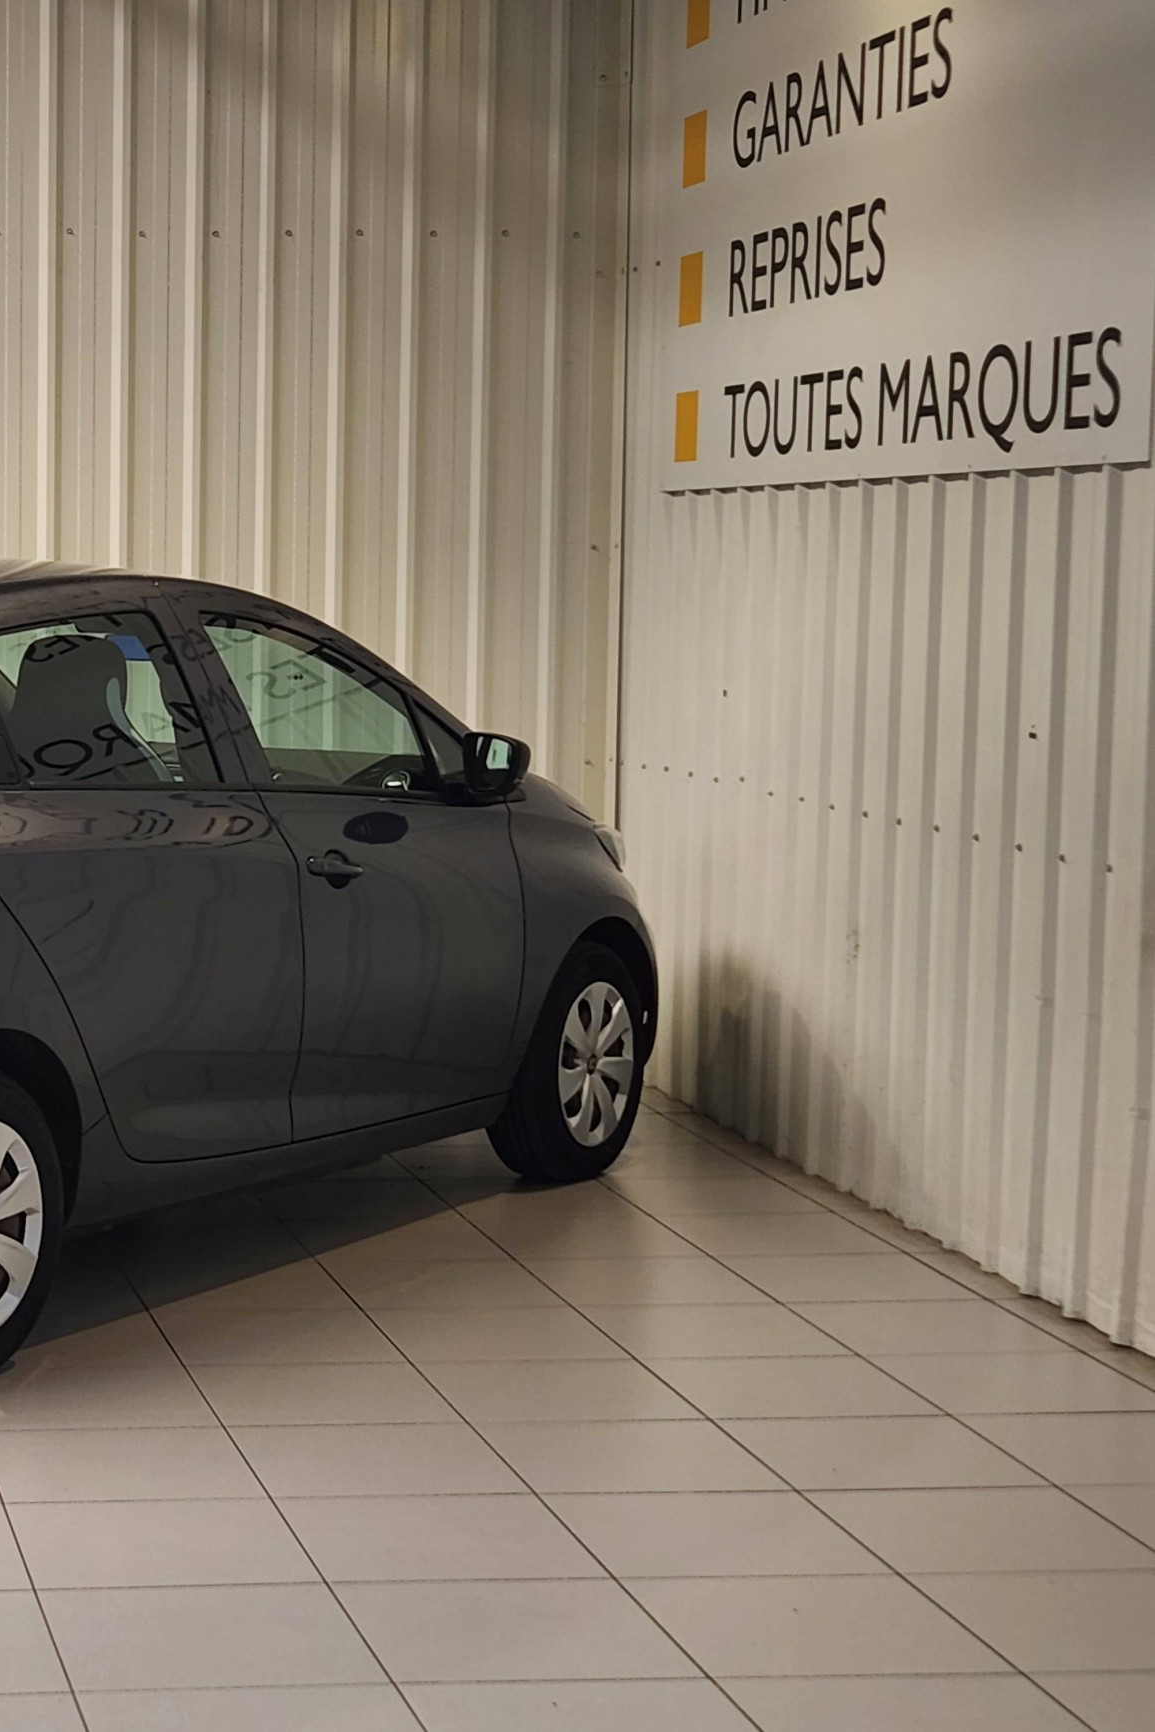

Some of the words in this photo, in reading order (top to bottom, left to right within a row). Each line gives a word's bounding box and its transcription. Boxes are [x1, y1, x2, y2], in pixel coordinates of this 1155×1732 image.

[733, 7, 953, 168] GARANTIES
[729, 198, 886, 317] REPRISES
[724, 366, 863, 458] TOUTES
[877, 327, 1122, 453] MARQUES
